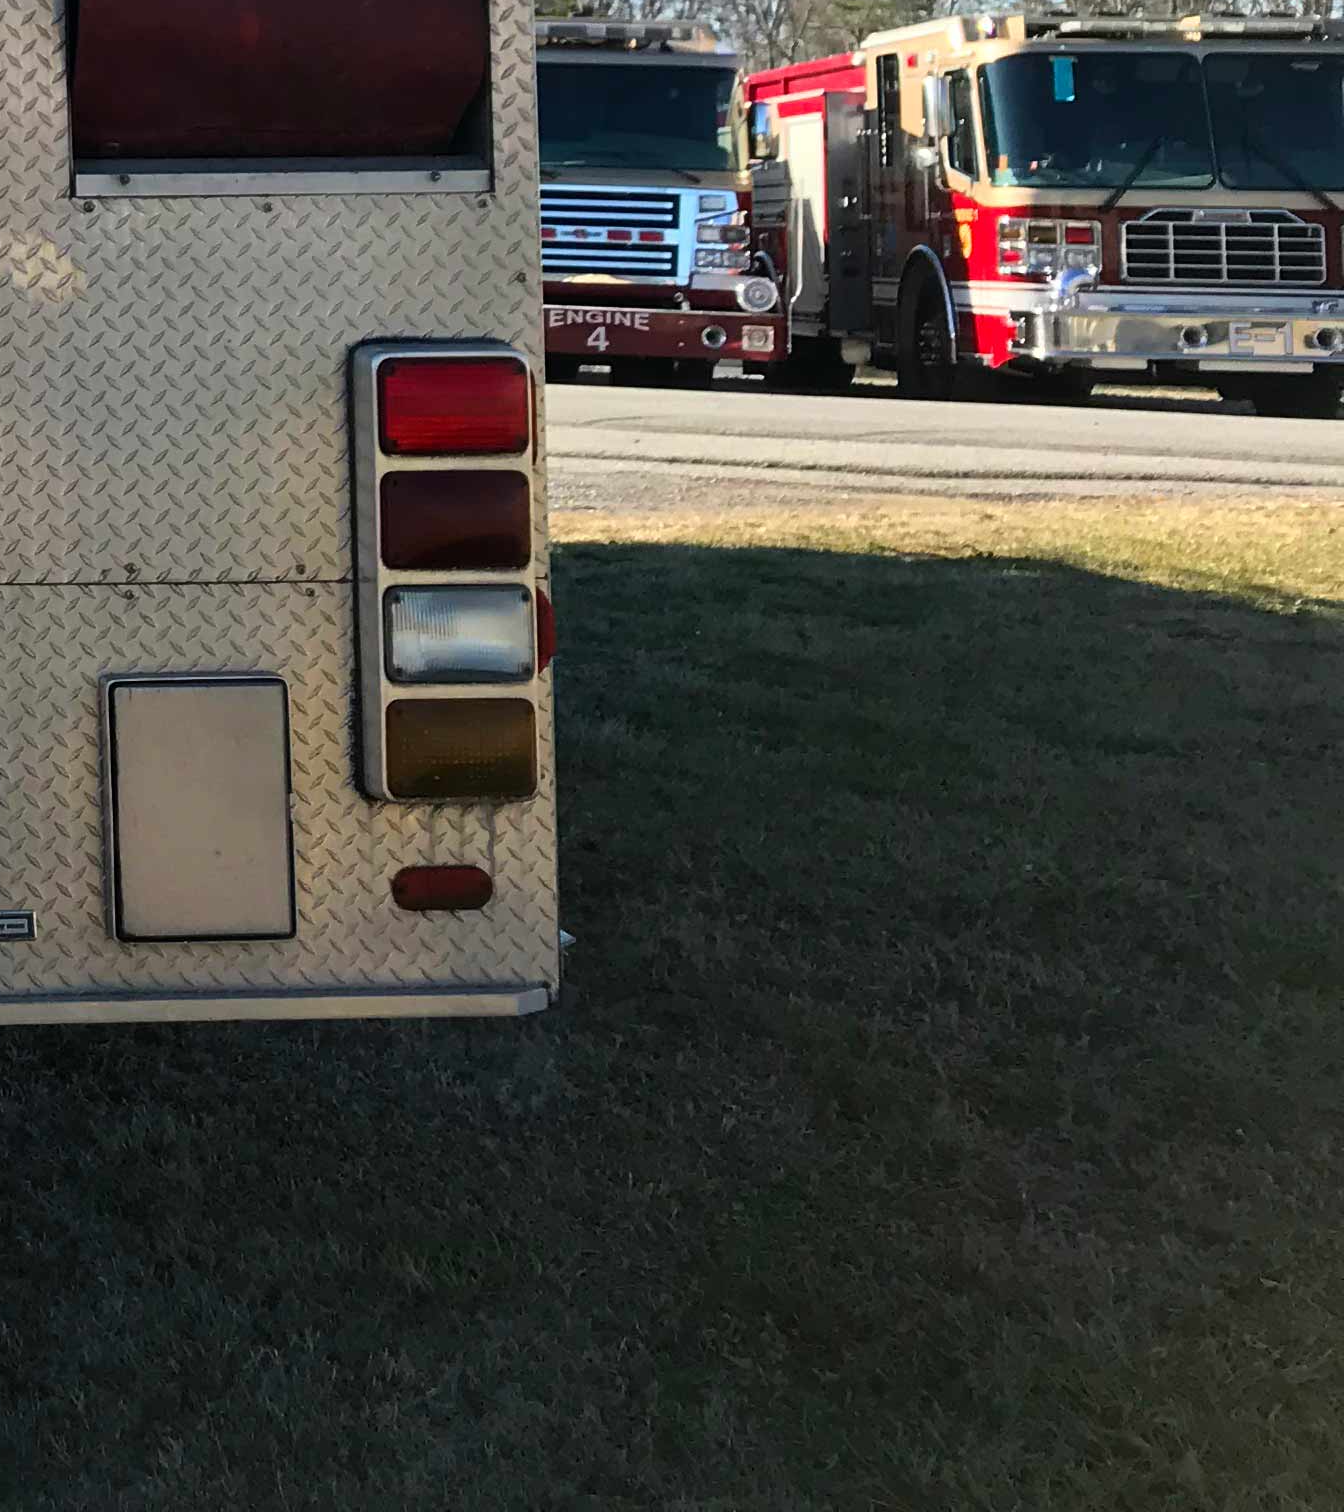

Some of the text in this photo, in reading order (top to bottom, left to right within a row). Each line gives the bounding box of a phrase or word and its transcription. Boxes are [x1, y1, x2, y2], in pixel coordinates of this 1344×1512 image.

[549, 310, 650, 331] ENGINE
[587, 326, 610, 351] 4
[1229, 321, 1293, 355] E-1
